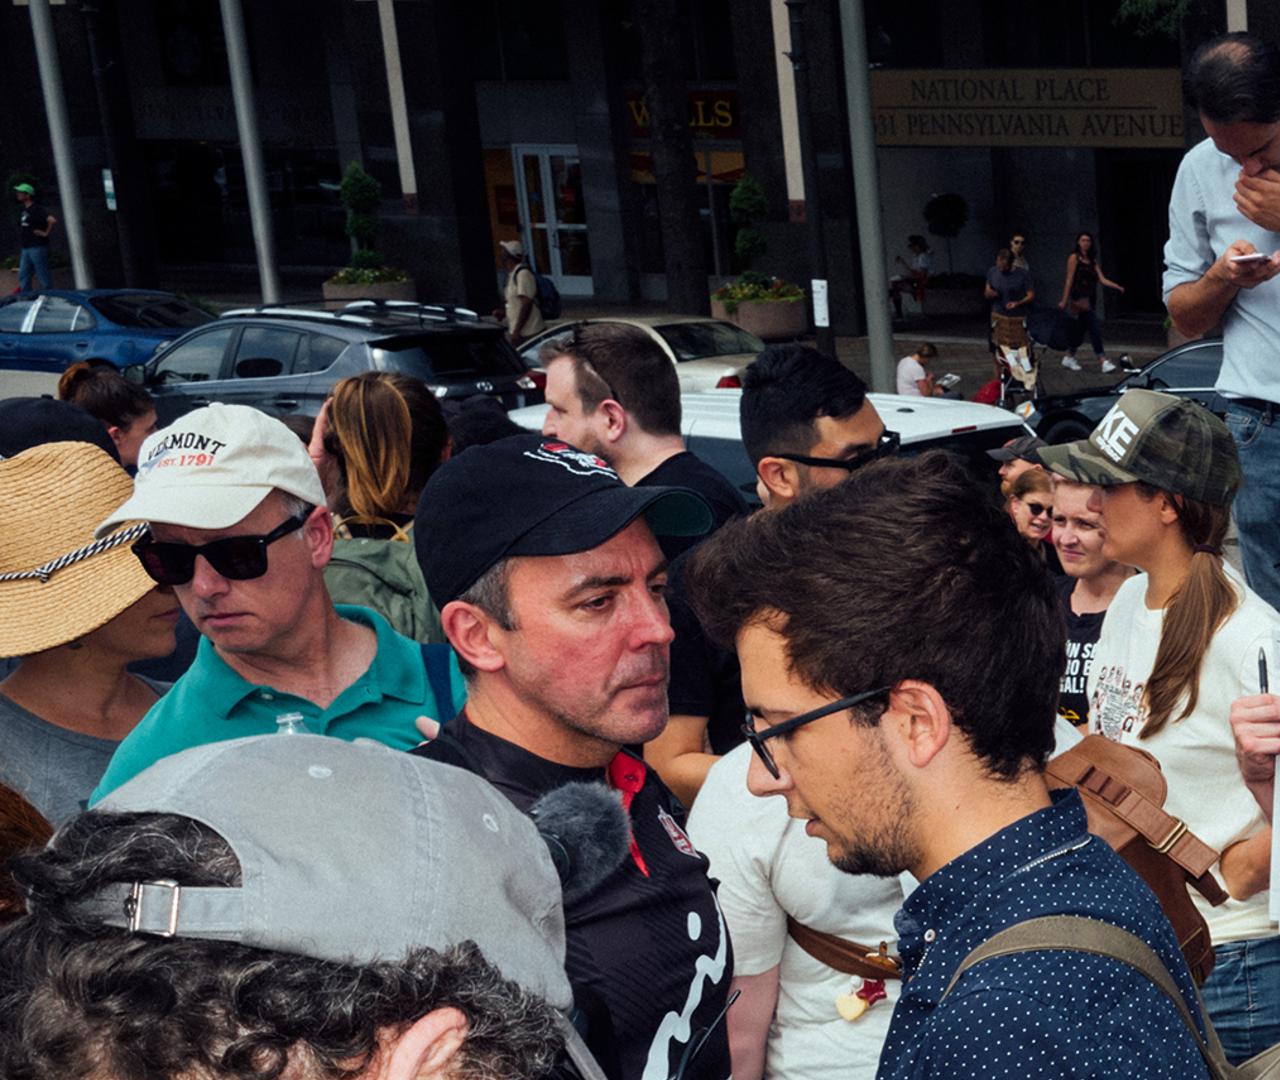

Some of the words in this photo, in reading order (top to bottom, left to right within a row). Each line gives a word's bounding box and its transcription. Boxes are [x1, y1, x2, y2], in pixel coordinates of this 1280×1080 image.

[911, 78, 1028, 101] NATIONAL
[1034, 78, 1111, 101] PLACE
[627, 97, 733, 127] WLS
[907, 114, 1069, 137] PENNSYLVANIA
[1081, 114, 1184, 137] AVENUE
